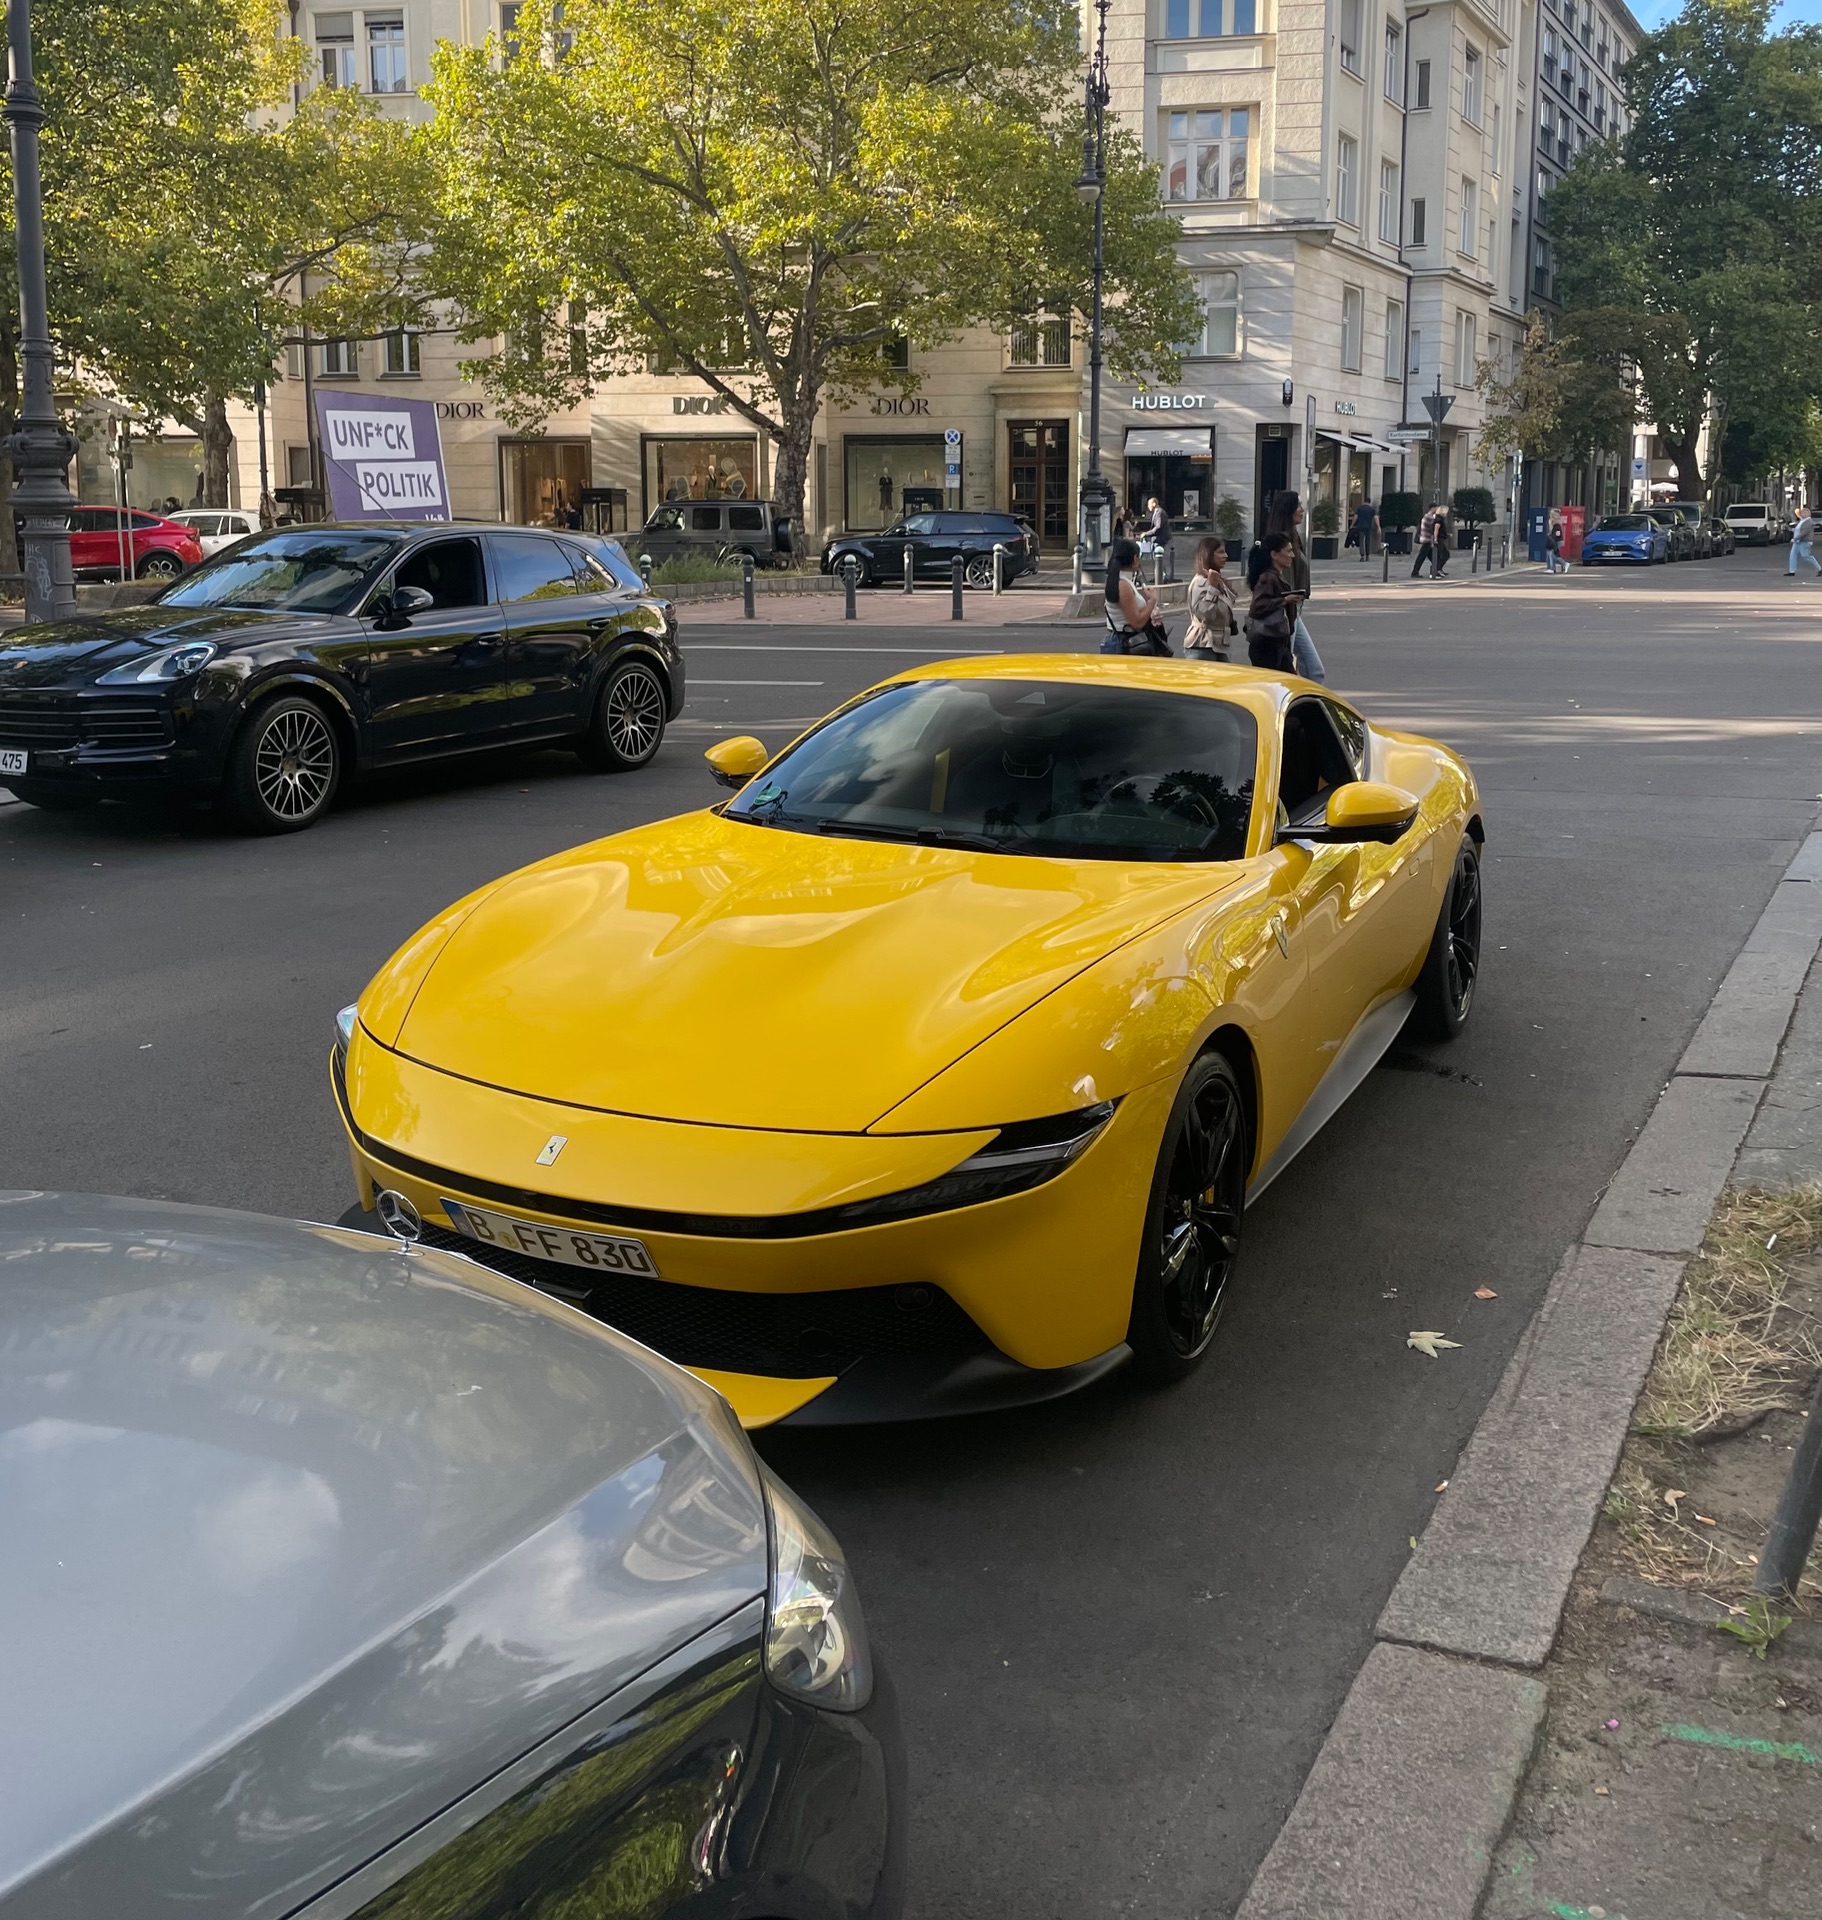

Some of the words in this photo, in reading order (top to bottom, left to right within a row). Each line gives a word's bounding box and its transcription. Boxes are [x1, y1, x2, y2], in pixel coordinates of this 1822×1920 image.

[437, 402, 486, 419] DIOR
[877, 398, 931, 416] DIOR
[1132, 395, 1206, 409] HUBLOT
[363, 472, 436, 498] POLITIK
[2, 753, 23, 769] 475
[465, 1211, 495, 1241] B
[512, 1224, 562, 1258] FF
[570, 1236, 651, 1272] 830
